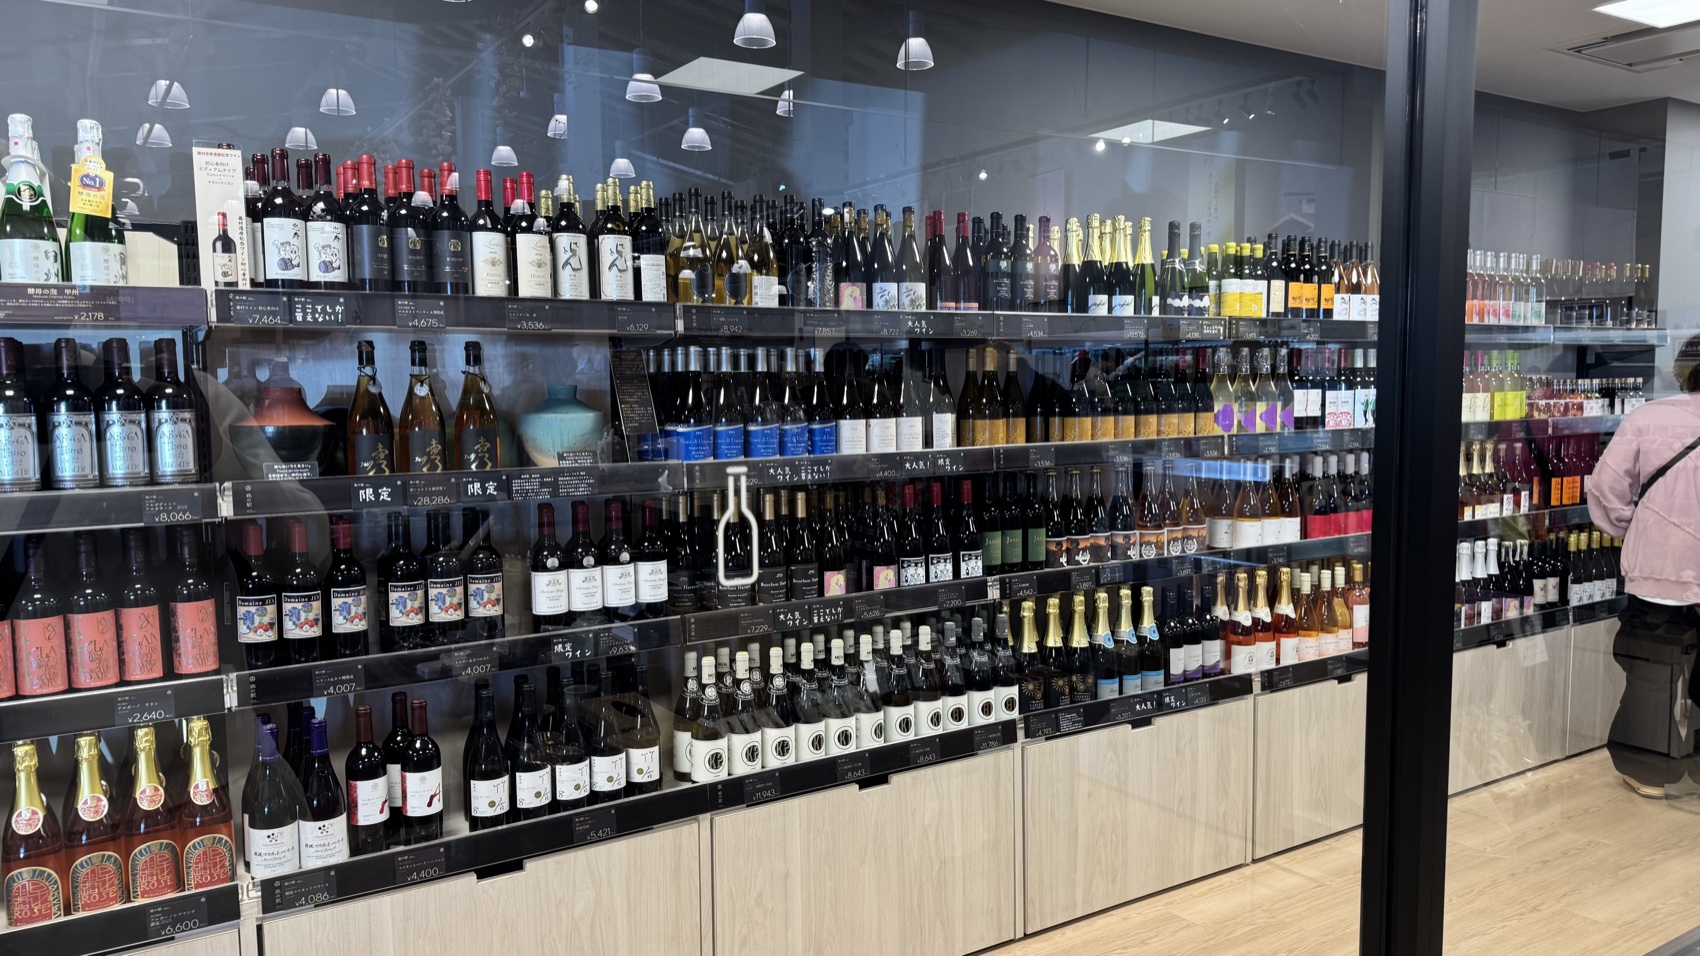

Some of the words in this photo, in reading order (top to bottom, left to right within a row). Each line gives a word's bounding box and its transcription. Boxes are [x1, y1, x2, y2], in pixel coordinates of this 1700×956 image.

[82, 176, 100, 188] No.1
[28, 288, 58, 296] 酵母の泡
[295, 304, 344, 314] ここでしか
[248, 314, 281, 325] ¥7,464
[295, 312, 342, 322] 買えない!
[408, 318, 438, 328] ¥4,675
[516, 321, 545, 330] ¥3,536
[626, 323, 649, 333] ¥6,129
[907, 320, 928, 328] 大人気
[720, 325, 743, 334] ¥8,942
[768, 466, 792, 475] 大人気
[800, 465, 832, 474] ここでしか
[904, 461, 930, 470] 大人気!
[777, 474, 799, 482] ワイン
[468, 481, 498, 496] 限定
[359, 487, 392, 502] 限定
[414, 495, 450, 506] ¥28,286
[154, 511, 192, 523] ¥8,066
[778, 611, 801, 621] 大人気
[813, 606, 844, 616] ここでしか
[861, 610, 880, 620] ¥5,626
[787, 618, 808, 627] ワイン
[748, 624, 768, 634] ¥7,229
[554, 643, 572, 653] 限定
[566, 650, 592, 659] ワイン
[462, 664, 491, 676] ¥4,007
[323, 682, 356, 696] ¥4,007
[1135, 700, 1156, 712] 大人気!
[128, 710, 164, 724] ¥2,640
[838, 730, 852, 746] K1
[775, 740, 790, 756] K2
[917, 754, 936, 764] ¥8,643
[844, 769, 866, 780] ¥8,643
[752, 789, 776, 801] ¥11,943
[586, 828, 611, 841] ¥5,421
[406, 867, 439, 882] ¥4,400
[294, 892, 330, 907] ¥4,086
[160, 918, 199, 936] ¥6,600
